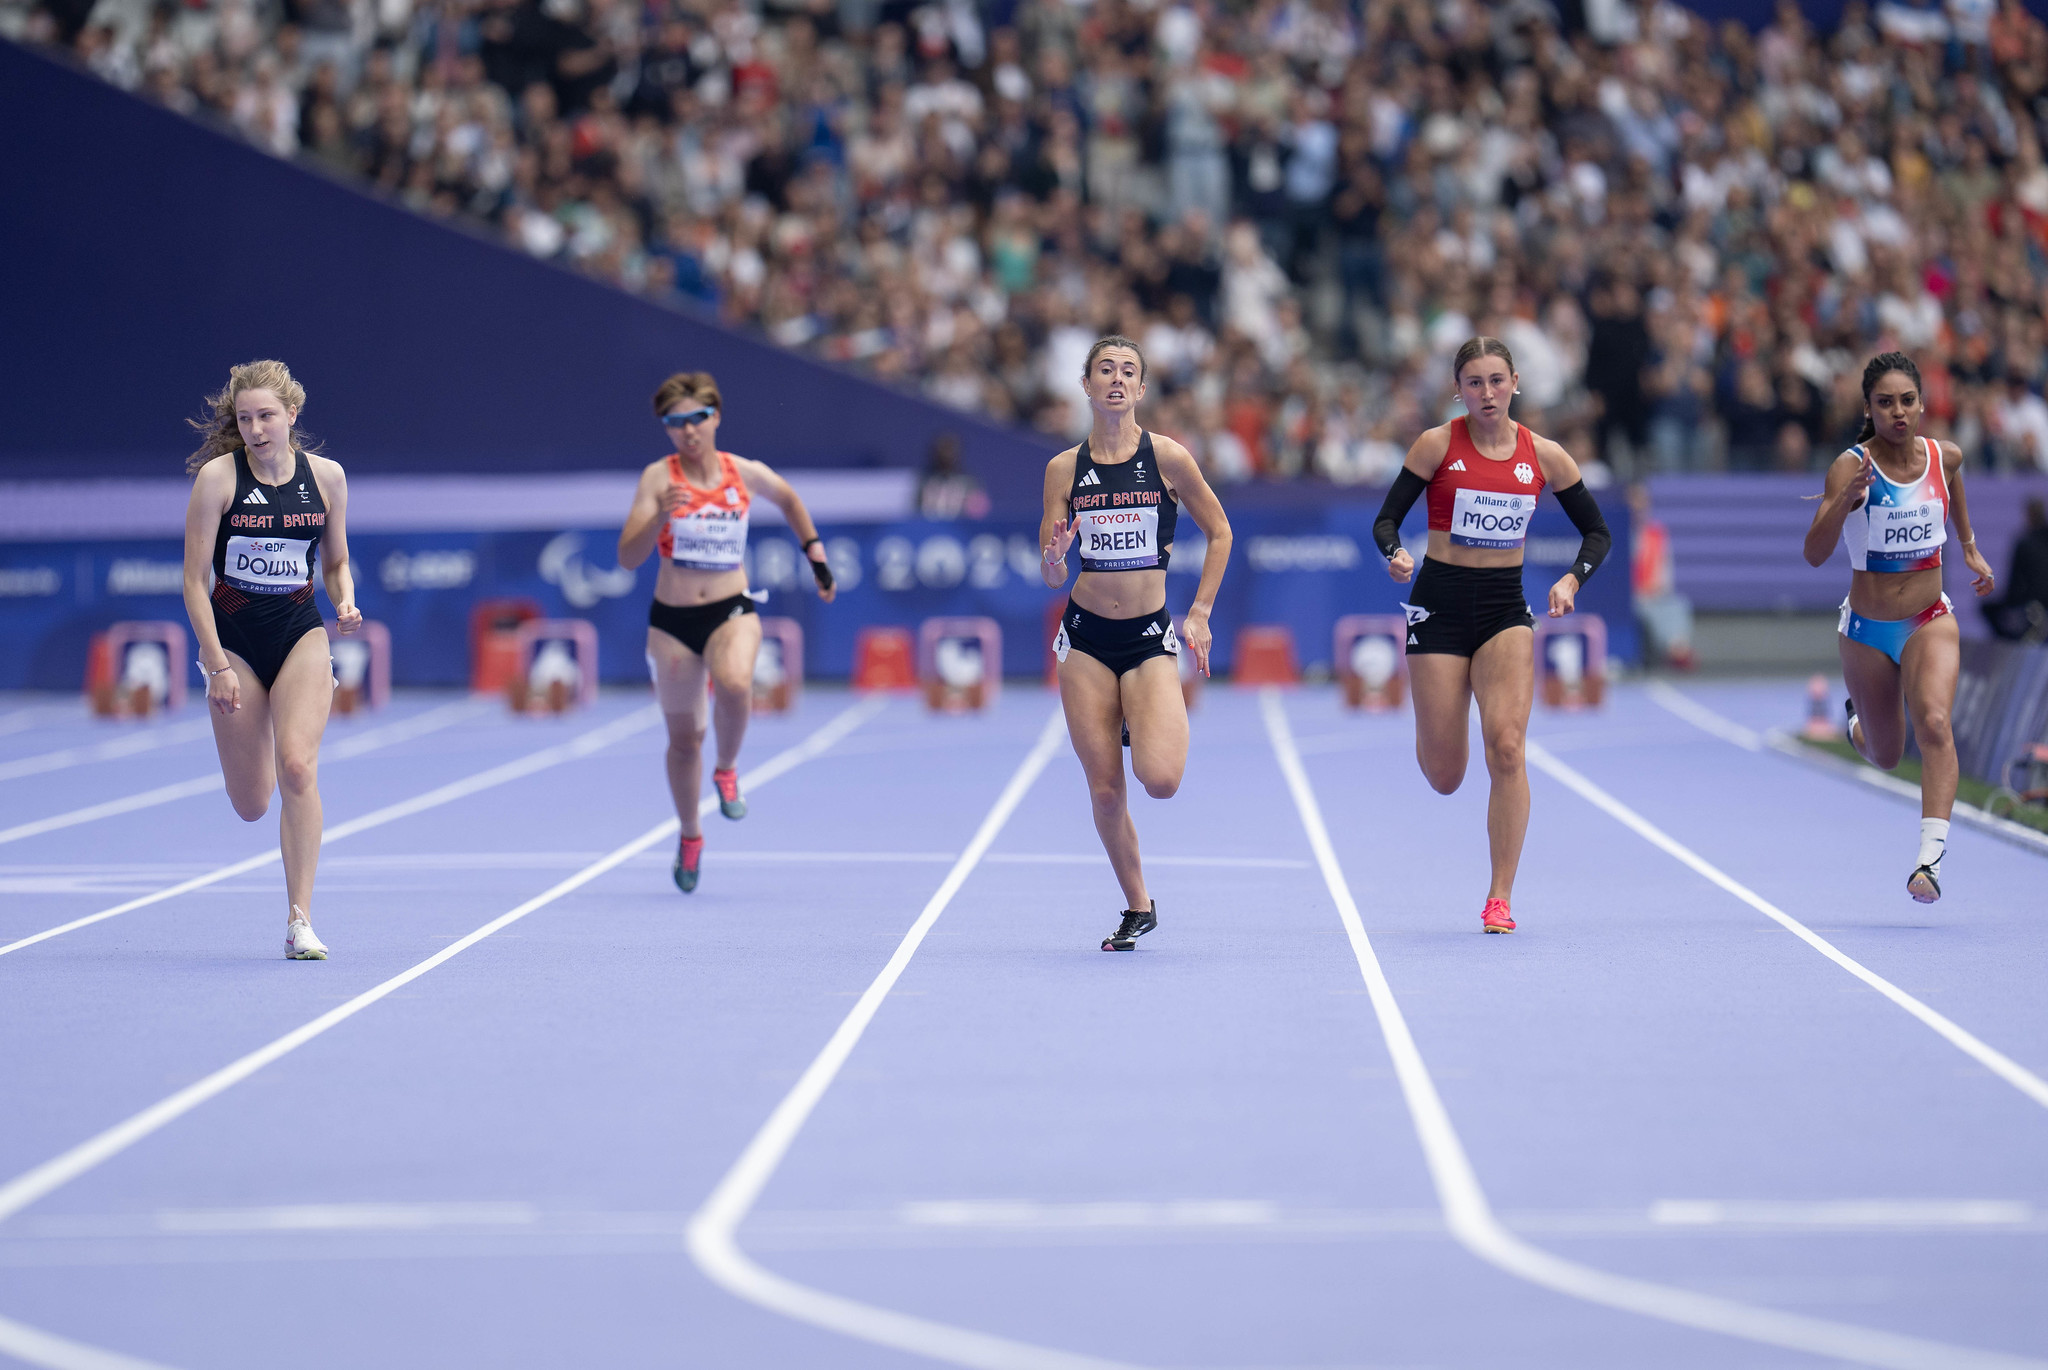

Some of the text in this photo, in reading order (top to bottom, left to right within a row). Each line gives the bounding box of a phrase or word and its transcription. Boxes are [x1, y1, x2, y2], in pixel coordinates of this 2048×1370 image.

[1073, 490, 1162, 510] GREAT BRITAIN
[1474, 495, 1508, 508] Allianz
[230, 514, 275, 528] GREAT
[1090, 513, 1142, 526] TOYOTA
[1463, 511, 1524, 532] MOOS
[1887, 509, 1919, 521] Allianz
[1090, 530, 1147, 551] BREEN
[1886, 523, 1932, 544] PACE
[1126, 559, 1144, 567] 2024
[1895, 552, 1916, 560] PARIS
[237, 553, 299, 577] DOWN
